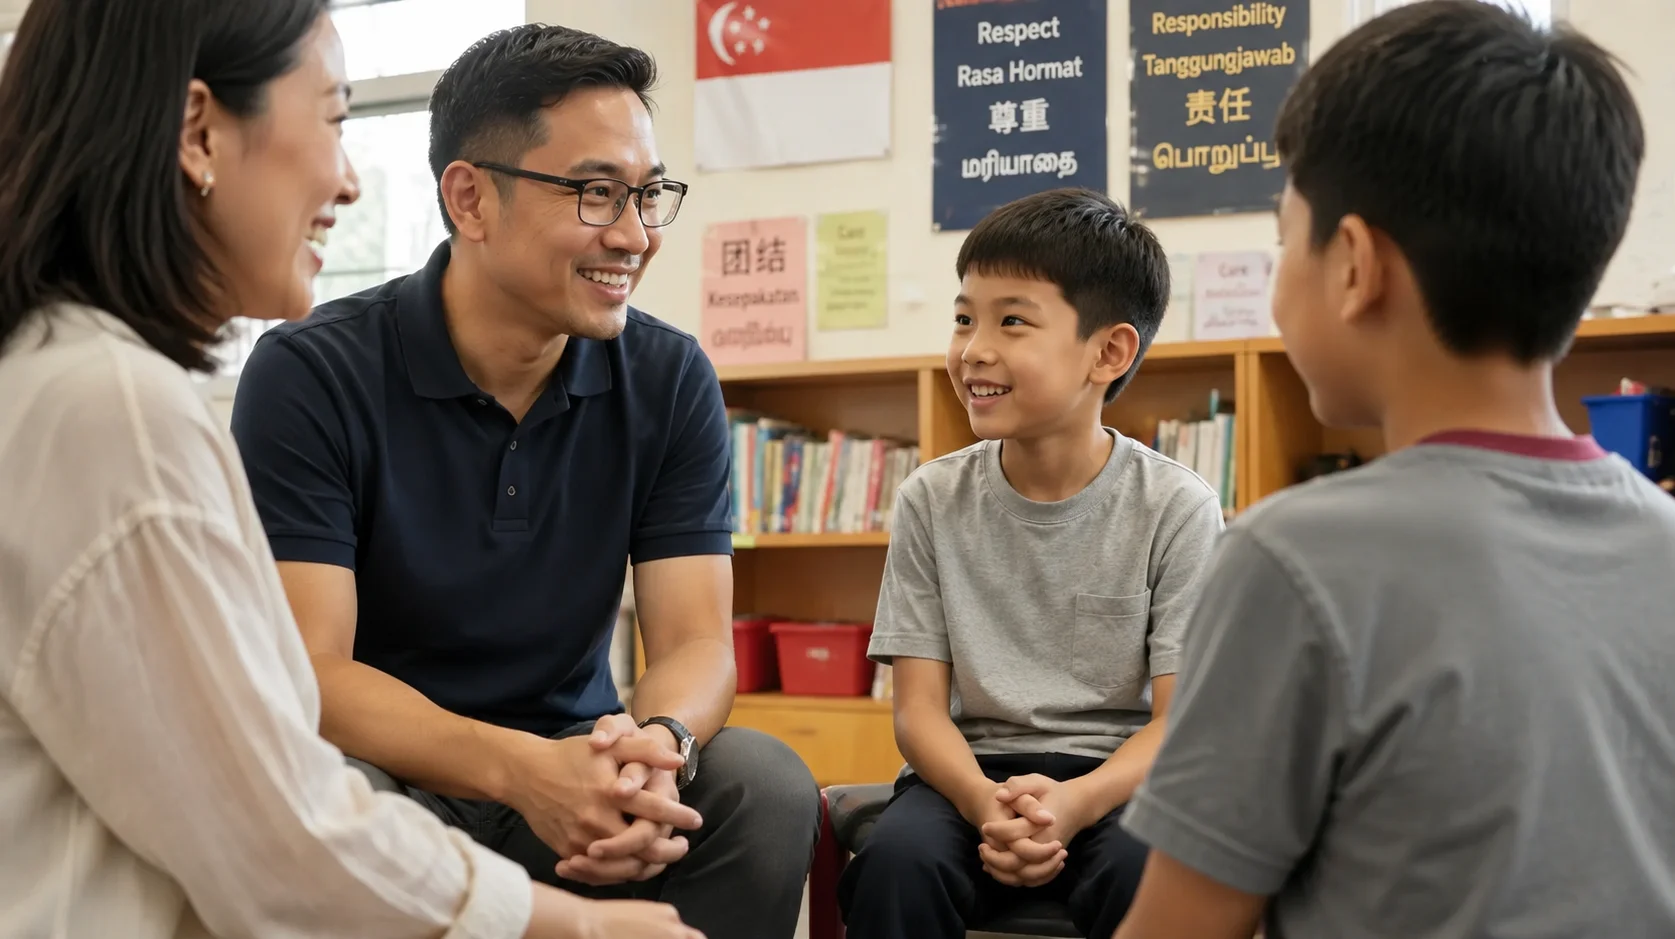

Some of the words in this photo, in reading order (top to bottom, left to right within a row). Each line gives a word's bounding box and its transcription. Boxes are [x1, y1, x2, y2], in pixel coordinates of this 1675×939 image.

[978, 16, 1061, 46] Respect
[1152, 3, 1286, 37] Responsibility
[957, 64, 1004, 88] Rasa
[1009, 56, 1083, 83] Hormat
[1142, 42, 1296, 80] Tanggungjawab
[988, 97, 1050, 135] 尊重
[1185, 87, 1252, 126] 责任
[961, 148, 1078, 183] மரியாதை
[722, 238, 787, 277] 团结
